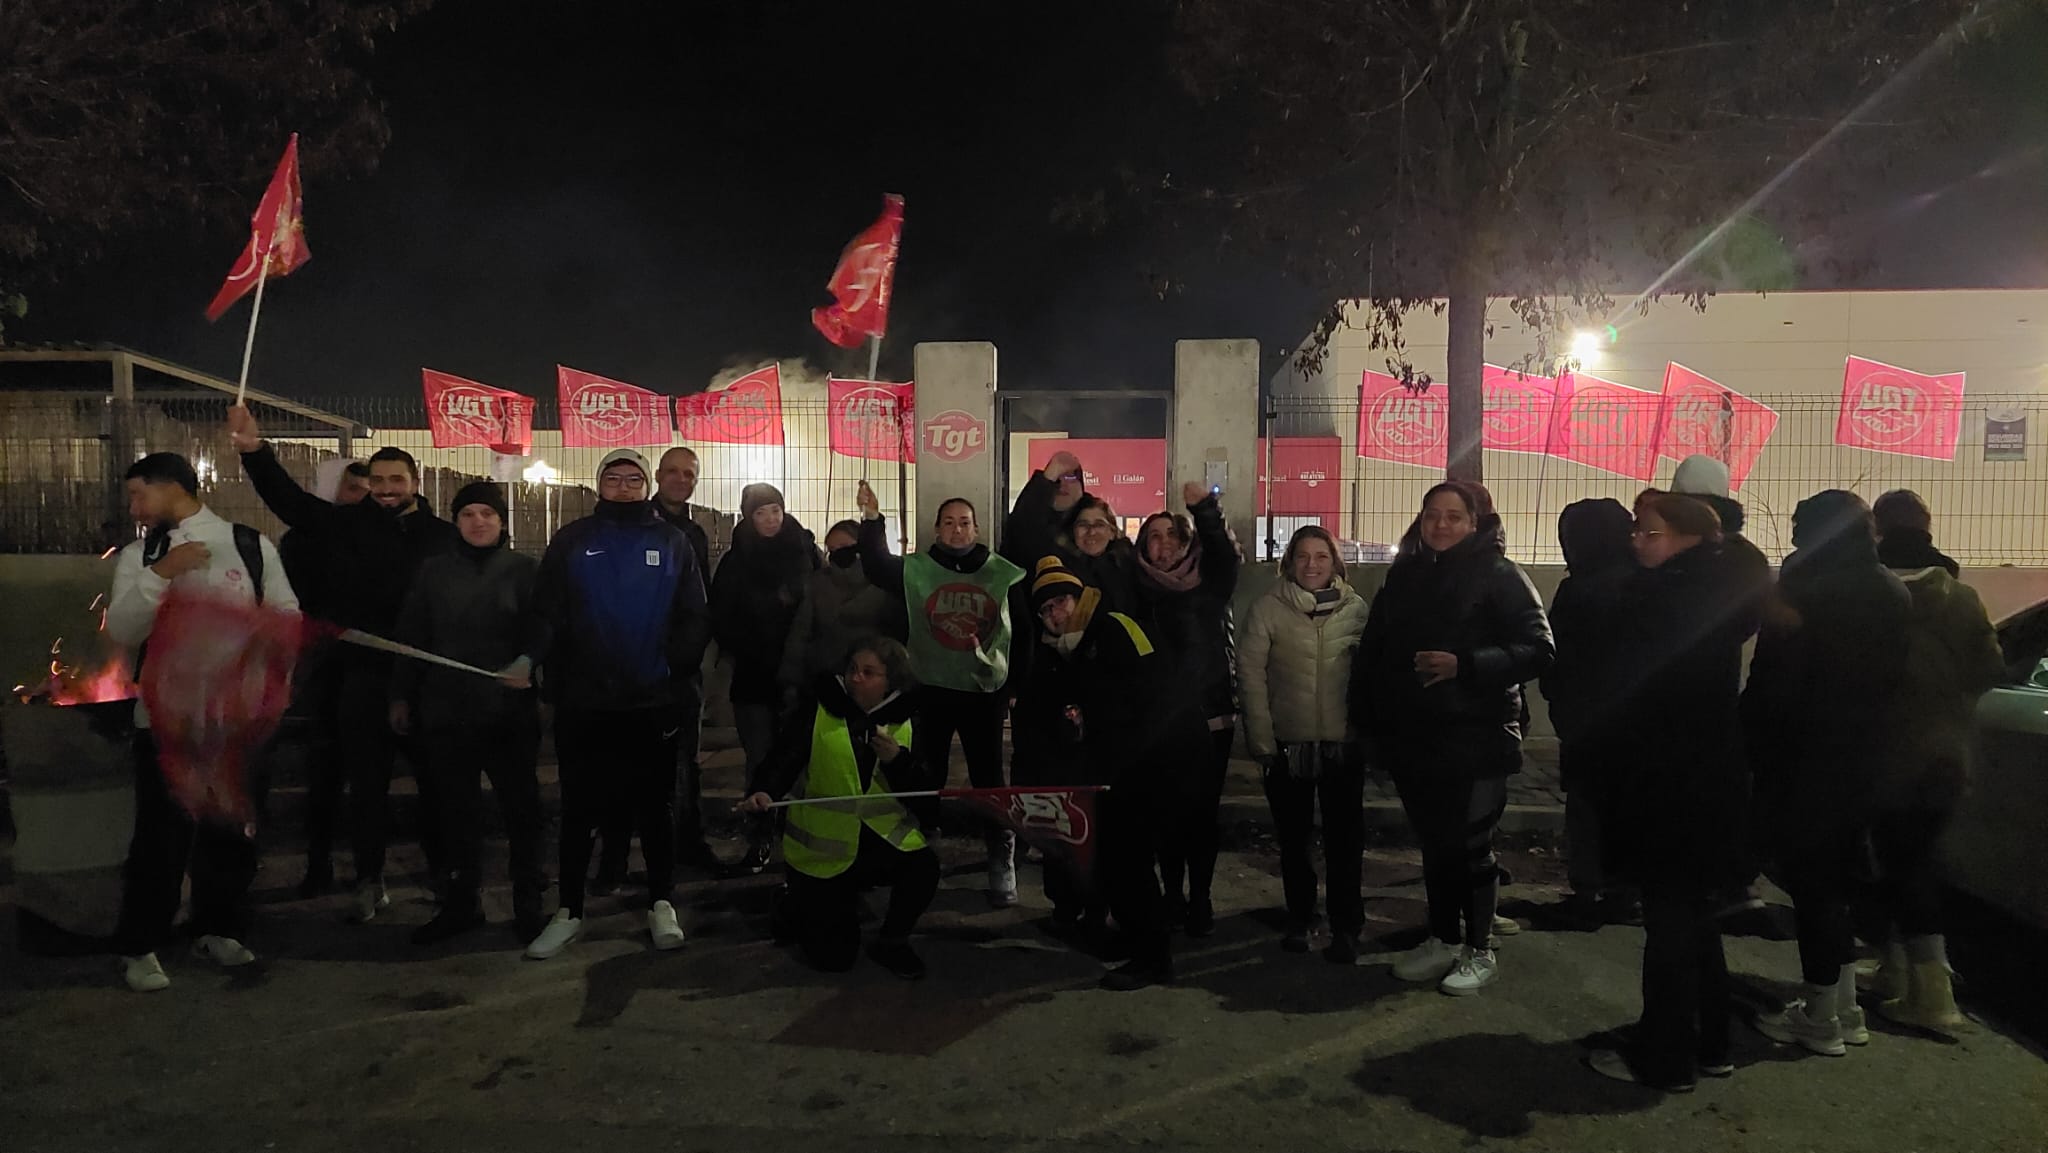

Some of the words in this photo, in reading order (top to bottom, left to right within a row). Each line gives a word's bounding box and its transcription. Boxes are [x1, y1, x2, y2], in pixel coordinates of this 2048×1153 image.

[447, 393, 494, 419] UGT
[581, 391, 630, 415] UGT
[844, 397, 895, 426] UGT
[1377, 396, 1438, 429] UGT
[1861, 382, 1918, 416] UGT
[1570, 396, 1630, 434] UGT
[927, 425, 981, 457] Tgt
[936, 590, 986, 618] UGT
